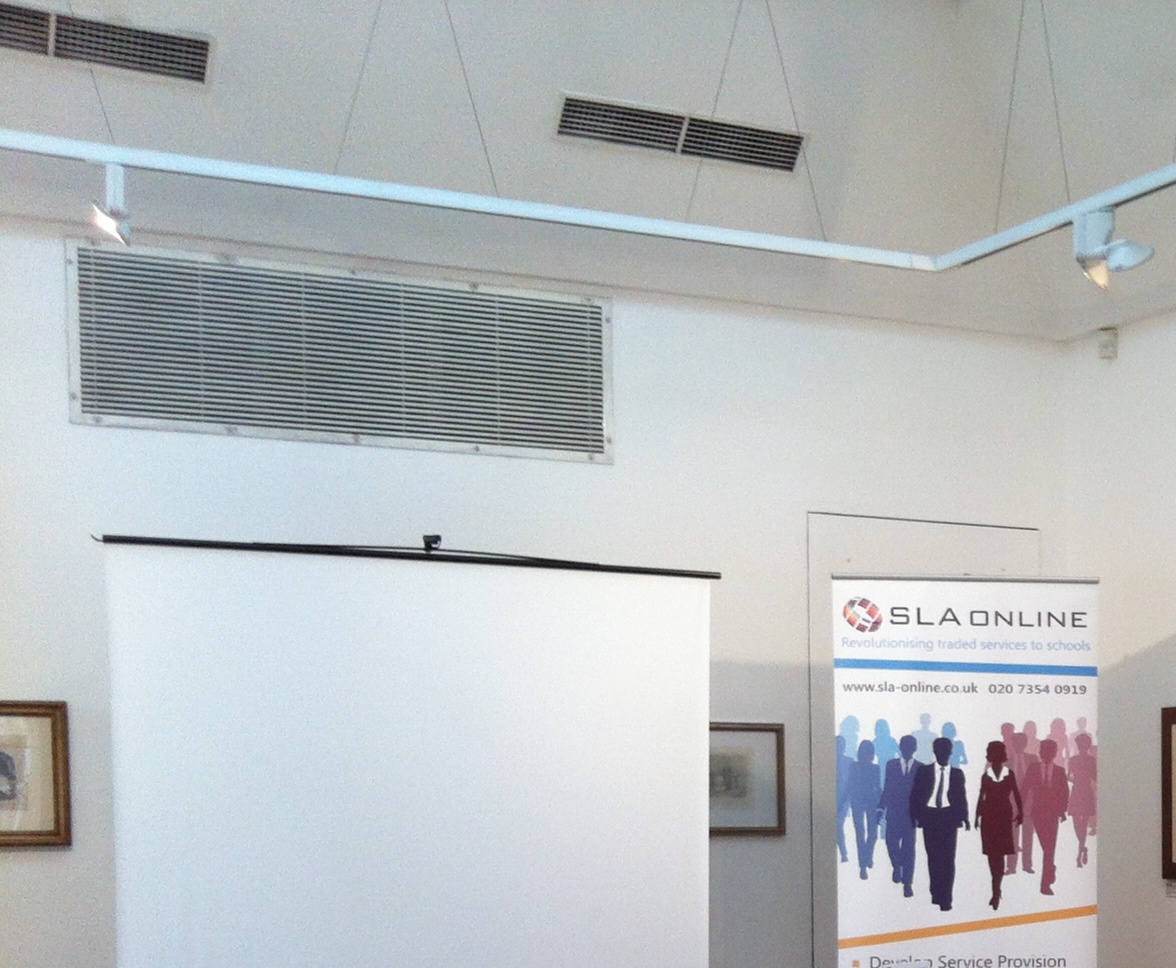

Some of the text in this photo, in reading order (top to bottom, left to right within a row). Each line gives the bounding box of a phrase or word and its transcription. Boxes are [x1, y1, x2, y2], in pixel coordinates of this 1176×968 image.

[890, 606, 1088, 628] SLA ONLINE
[841, 637, 1091, 652] Revolutionising traded services to schools
[842, 682, 978, 694] www.sla-online.co.uk
[989, 684, 1087, 695] 020 7354 0919
[938, 955, 993, 968] Service
[997, 955, 1067, 968] Provision
